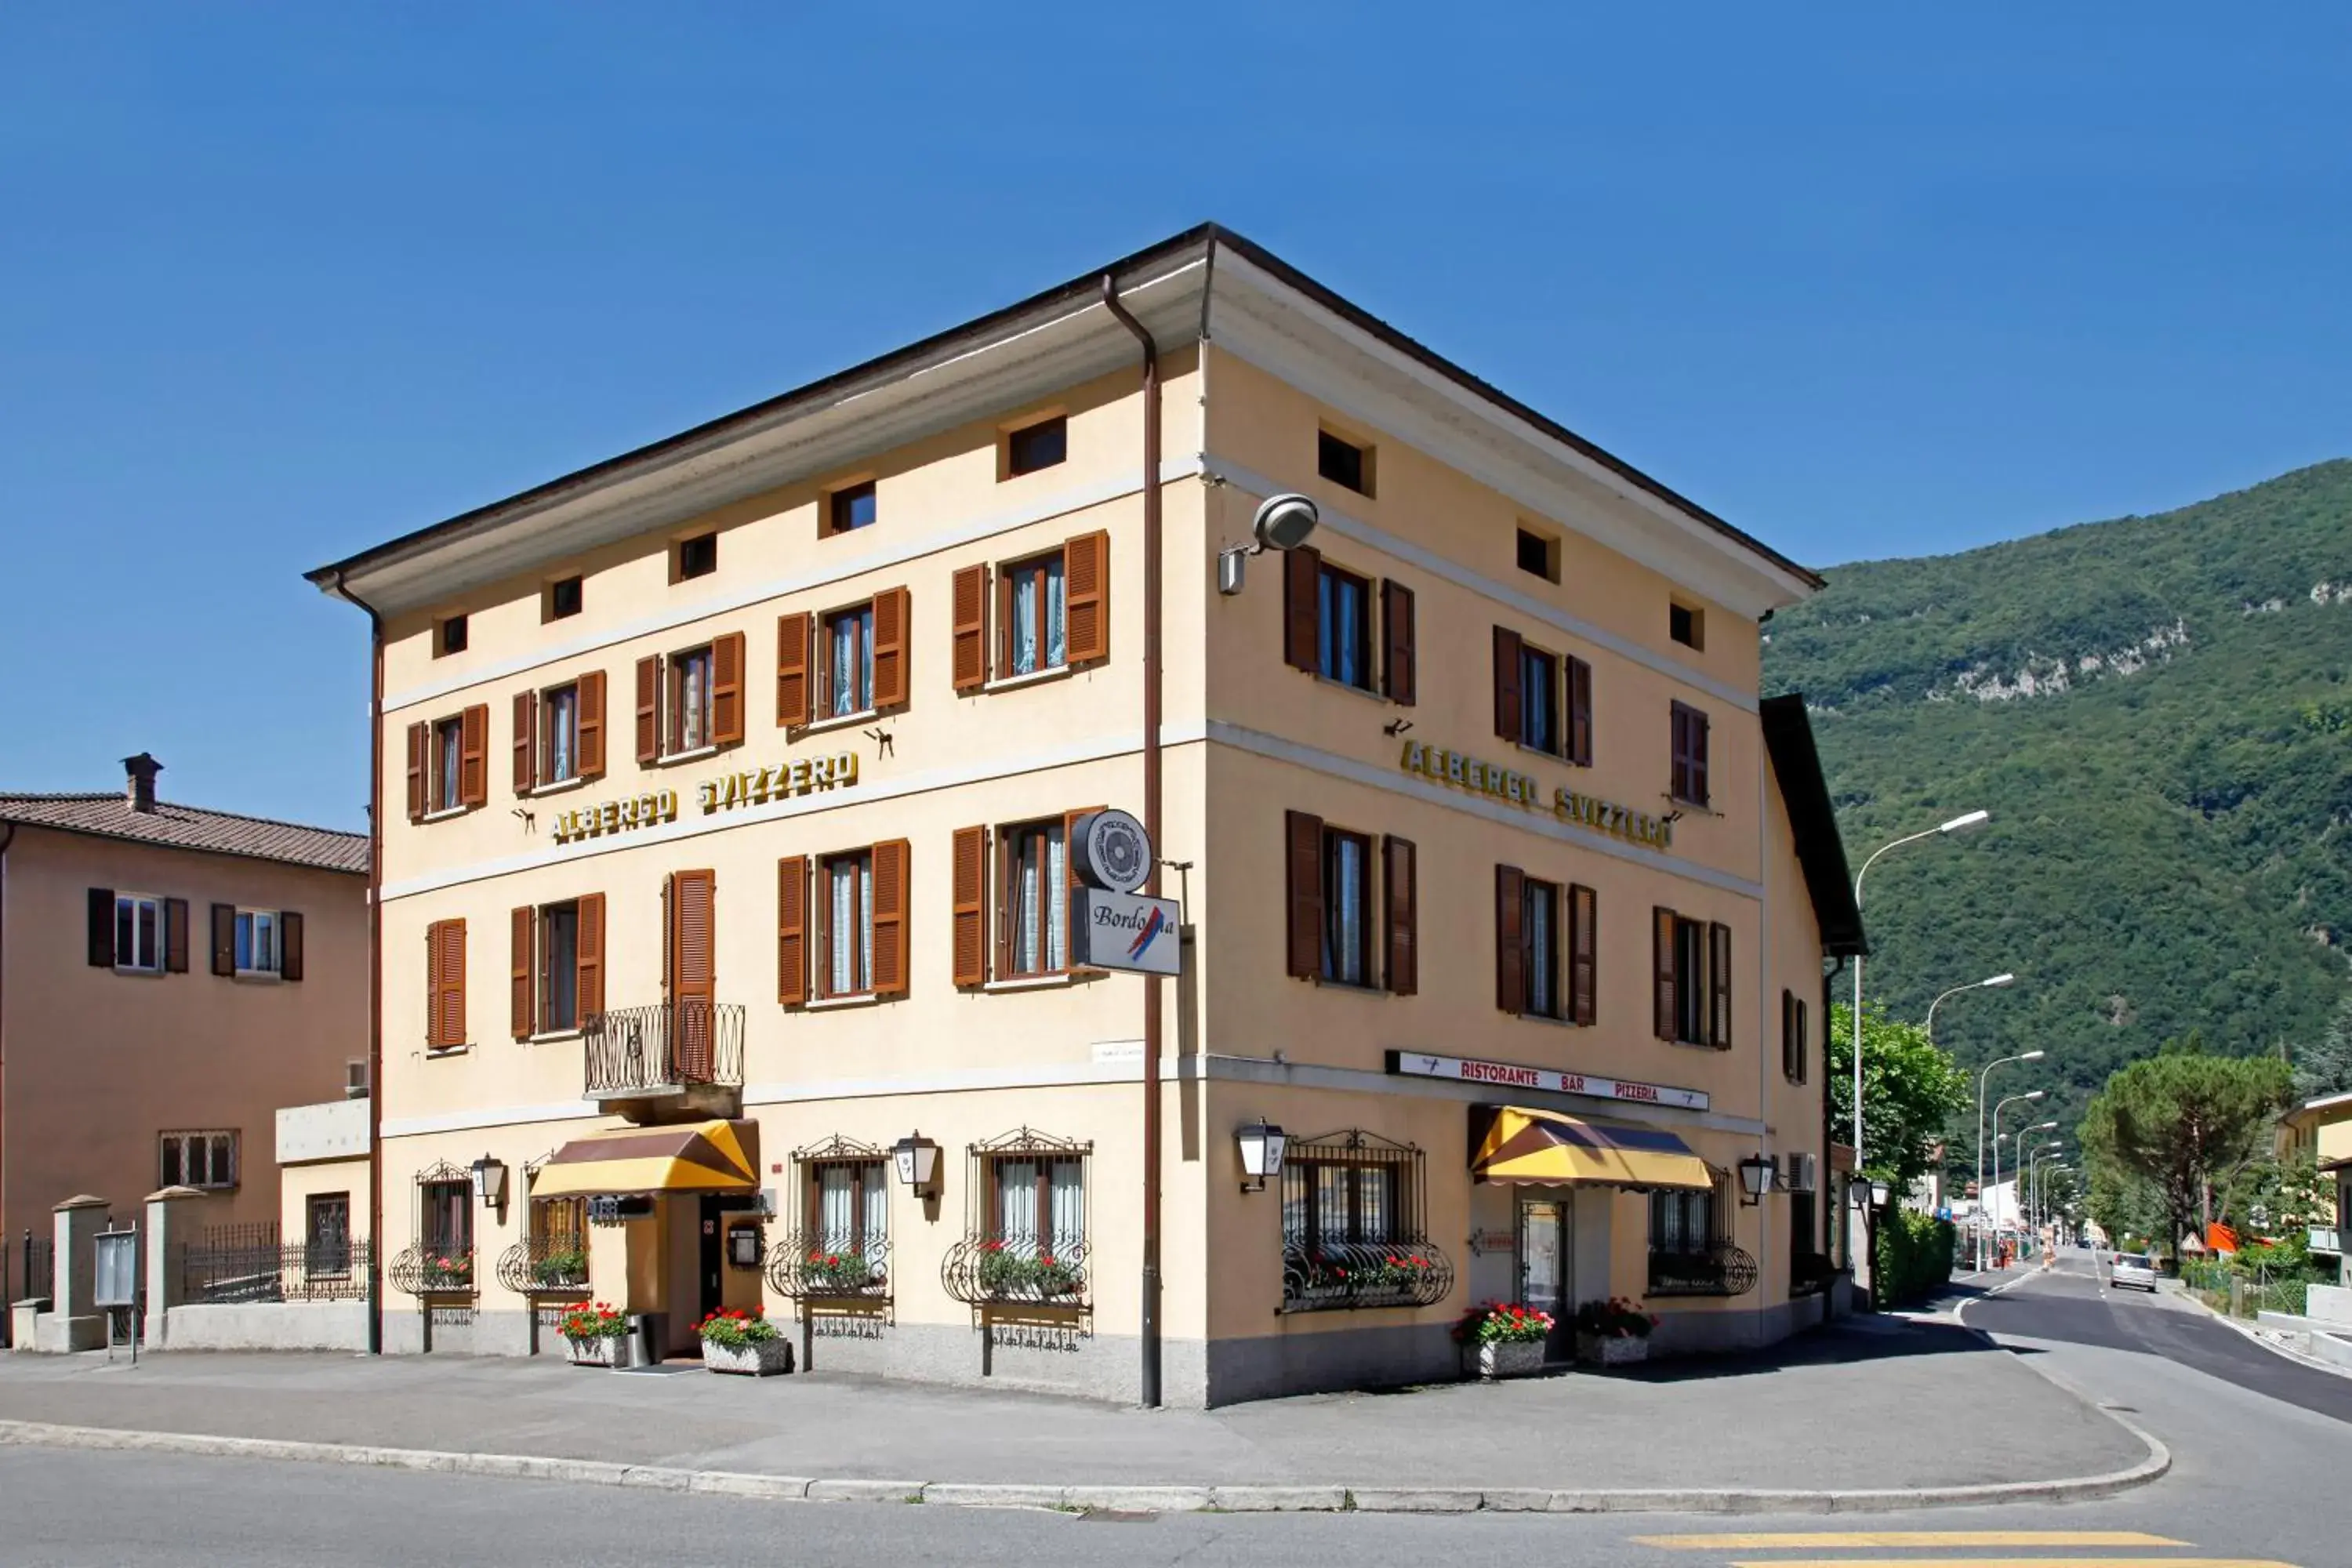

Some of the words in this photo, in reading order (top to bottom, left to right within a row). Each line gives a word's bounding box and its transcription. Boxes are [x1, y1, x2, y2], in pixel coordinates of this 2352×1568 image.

[552, 788, 677, 840] ALBERGO
[695, 750, 858, 809] SVIZZERO
[1401, 739, 1539, 808] ALBERGO
[1554, 785, 1672, 849] SVIZZERO
[1461, 1061, 1540, 1086] RISTORANTE
[1561, 1075, 1584, 1092] BAR
[1615, 1083, 1658, 1102] PIZZERIA
